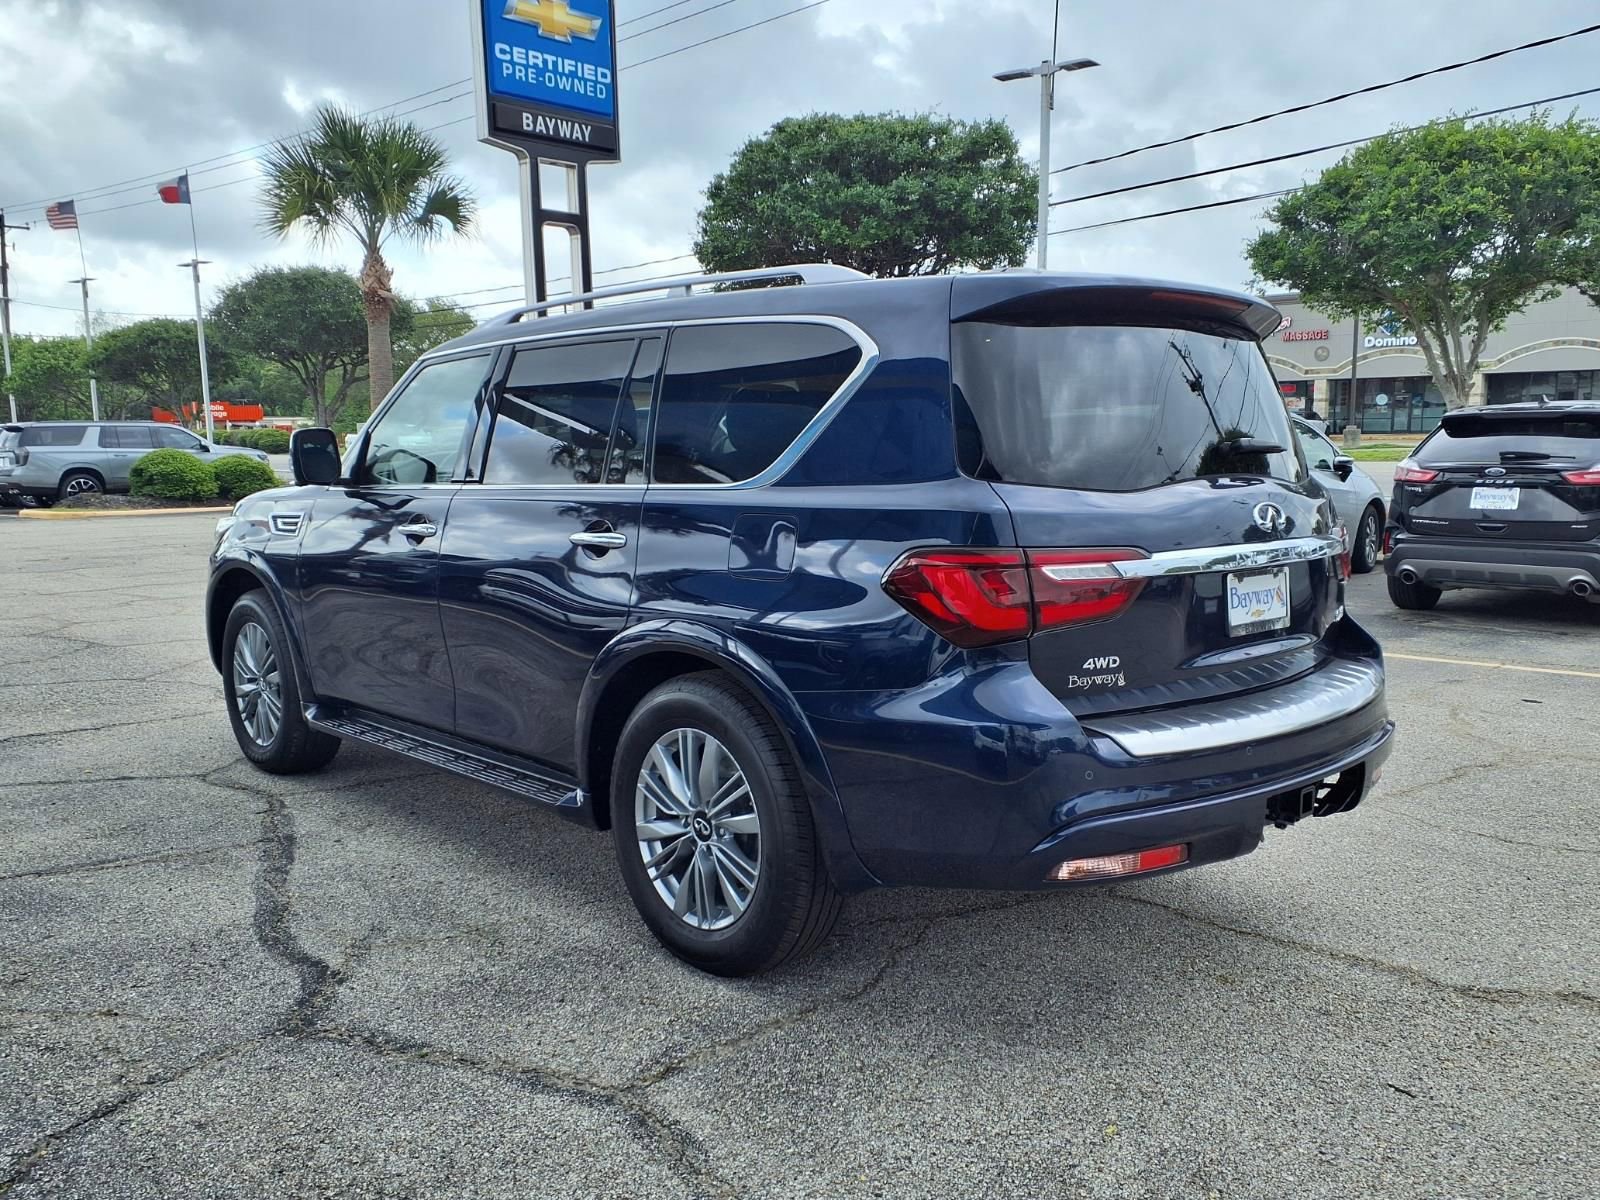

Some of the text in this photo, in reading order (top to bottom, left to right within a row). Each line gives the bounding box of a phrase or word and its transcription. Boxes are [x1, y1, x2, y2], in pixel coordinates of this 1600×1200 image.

[494, 42, 611, 84] CERTIFIED
[502, 62, 607, 99] PRE-OWNED
[522, 112, 592, 143] BAYWAY
[1281, 329, 1329, 342] MASSAGE
[1364, 336, 1418, 348] Domino
[1230, 587, 1276, 615] Bayway
[1083, 656, 1120, 670] 4WD
[1068, 674, 1119, 690] Bayway
